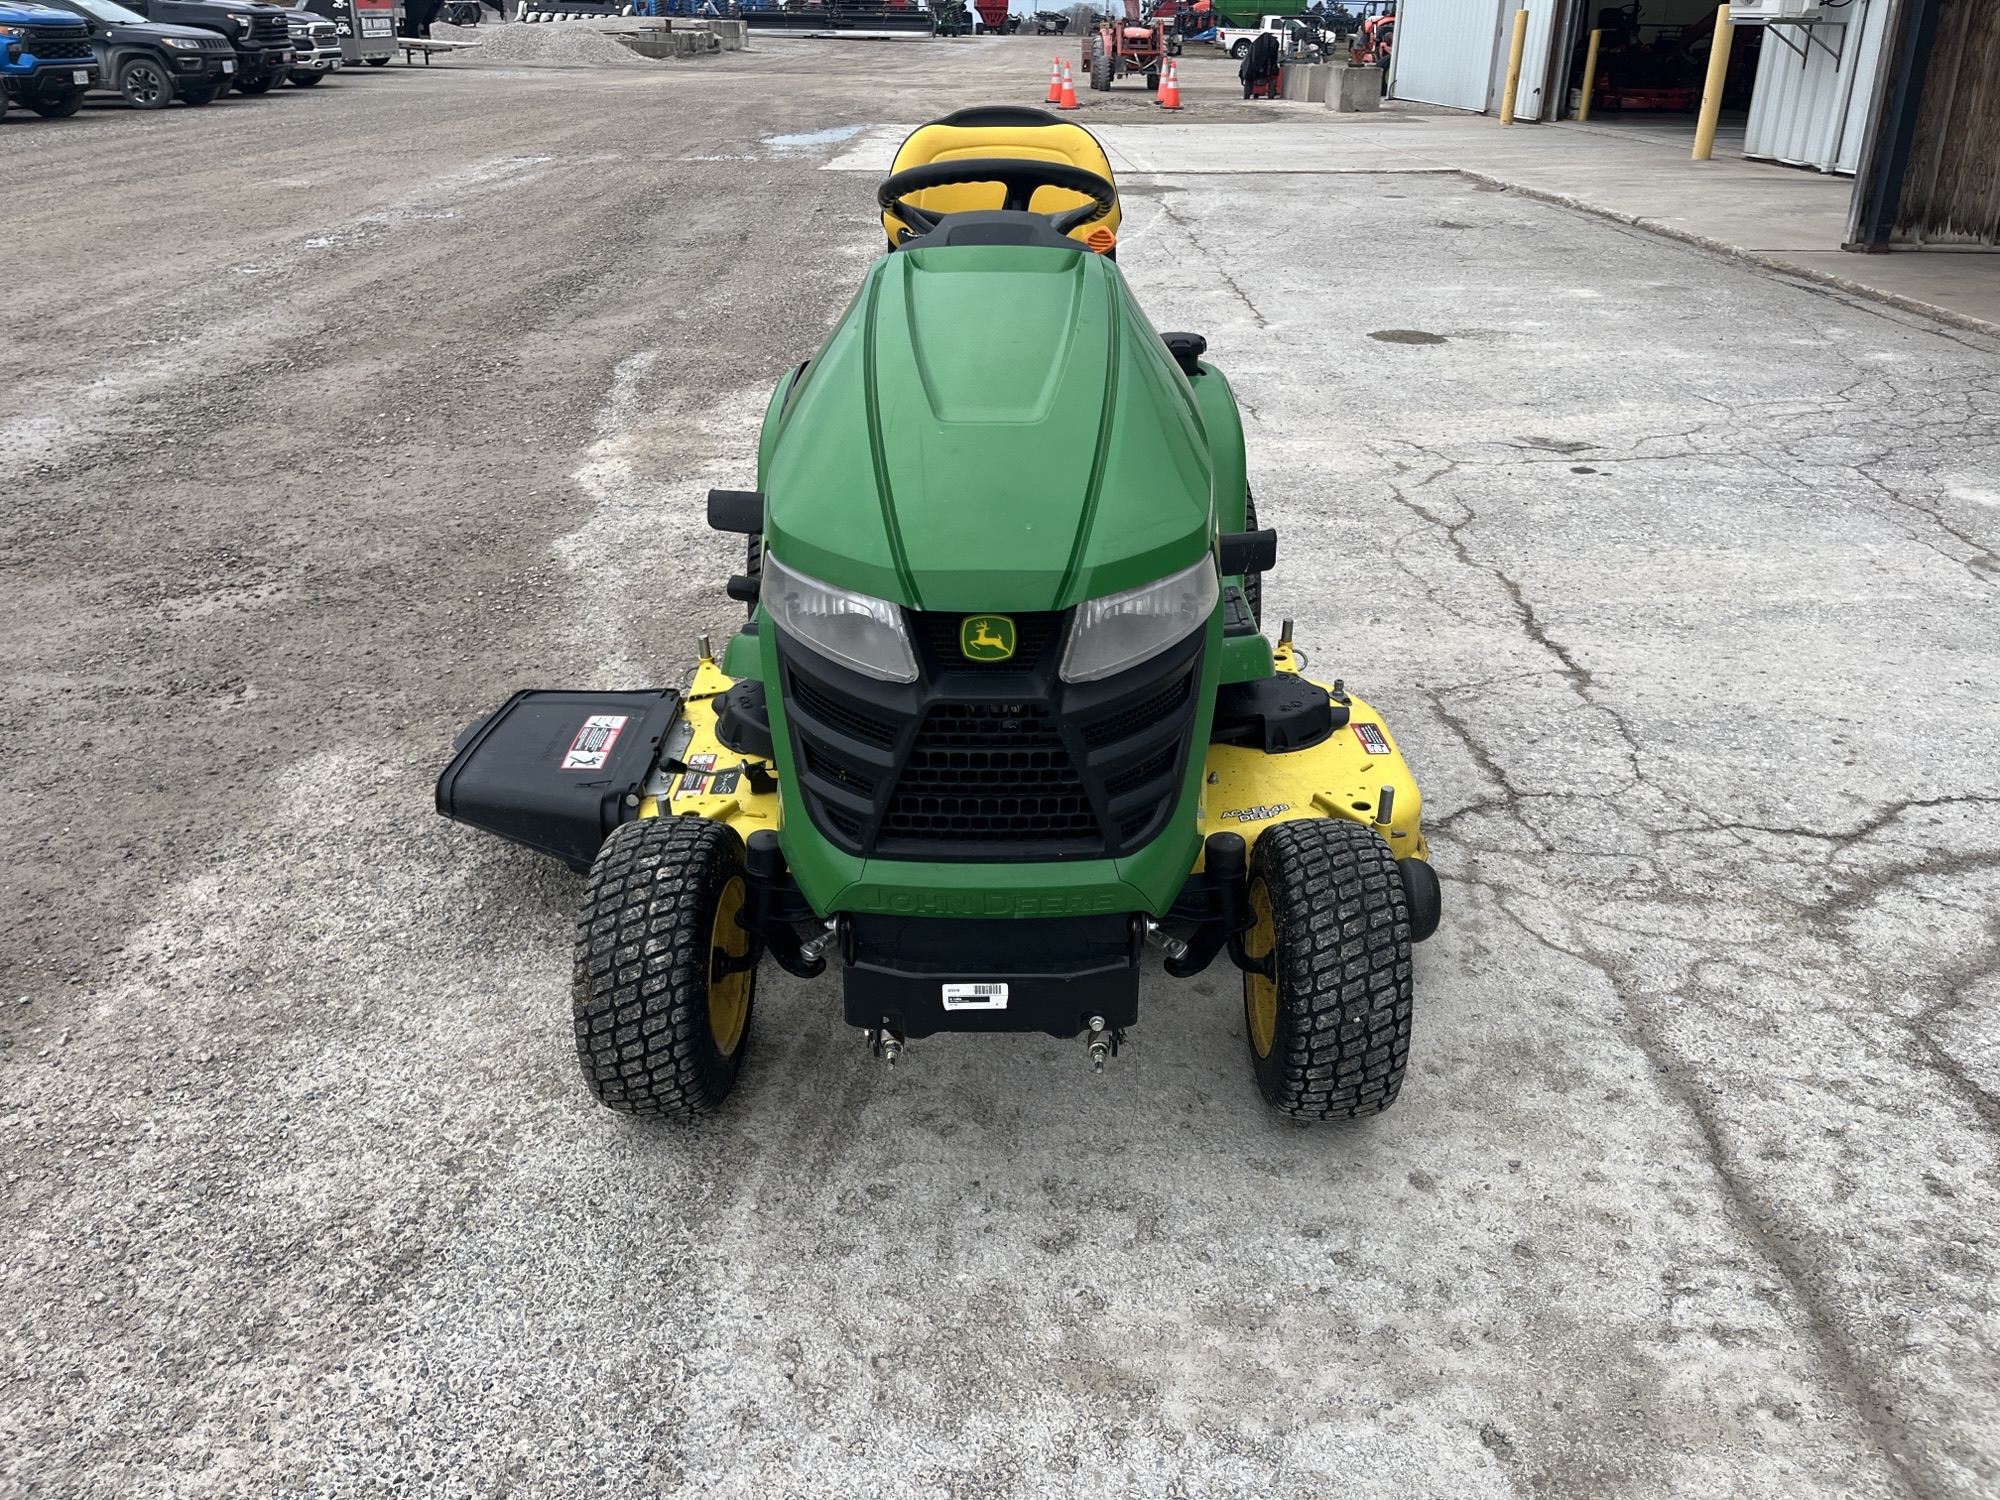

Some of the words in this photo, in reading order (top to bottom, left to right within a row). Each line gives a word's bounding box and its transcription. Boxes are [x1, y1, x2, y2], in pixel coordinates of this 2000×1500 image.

[1220, 805, 1266, 819] ACCEL
[1238, 809, 1279, 823] DEEP
[866, 887, 973, 914] JOHN
[983, 890, 1116, 915] DEERE
